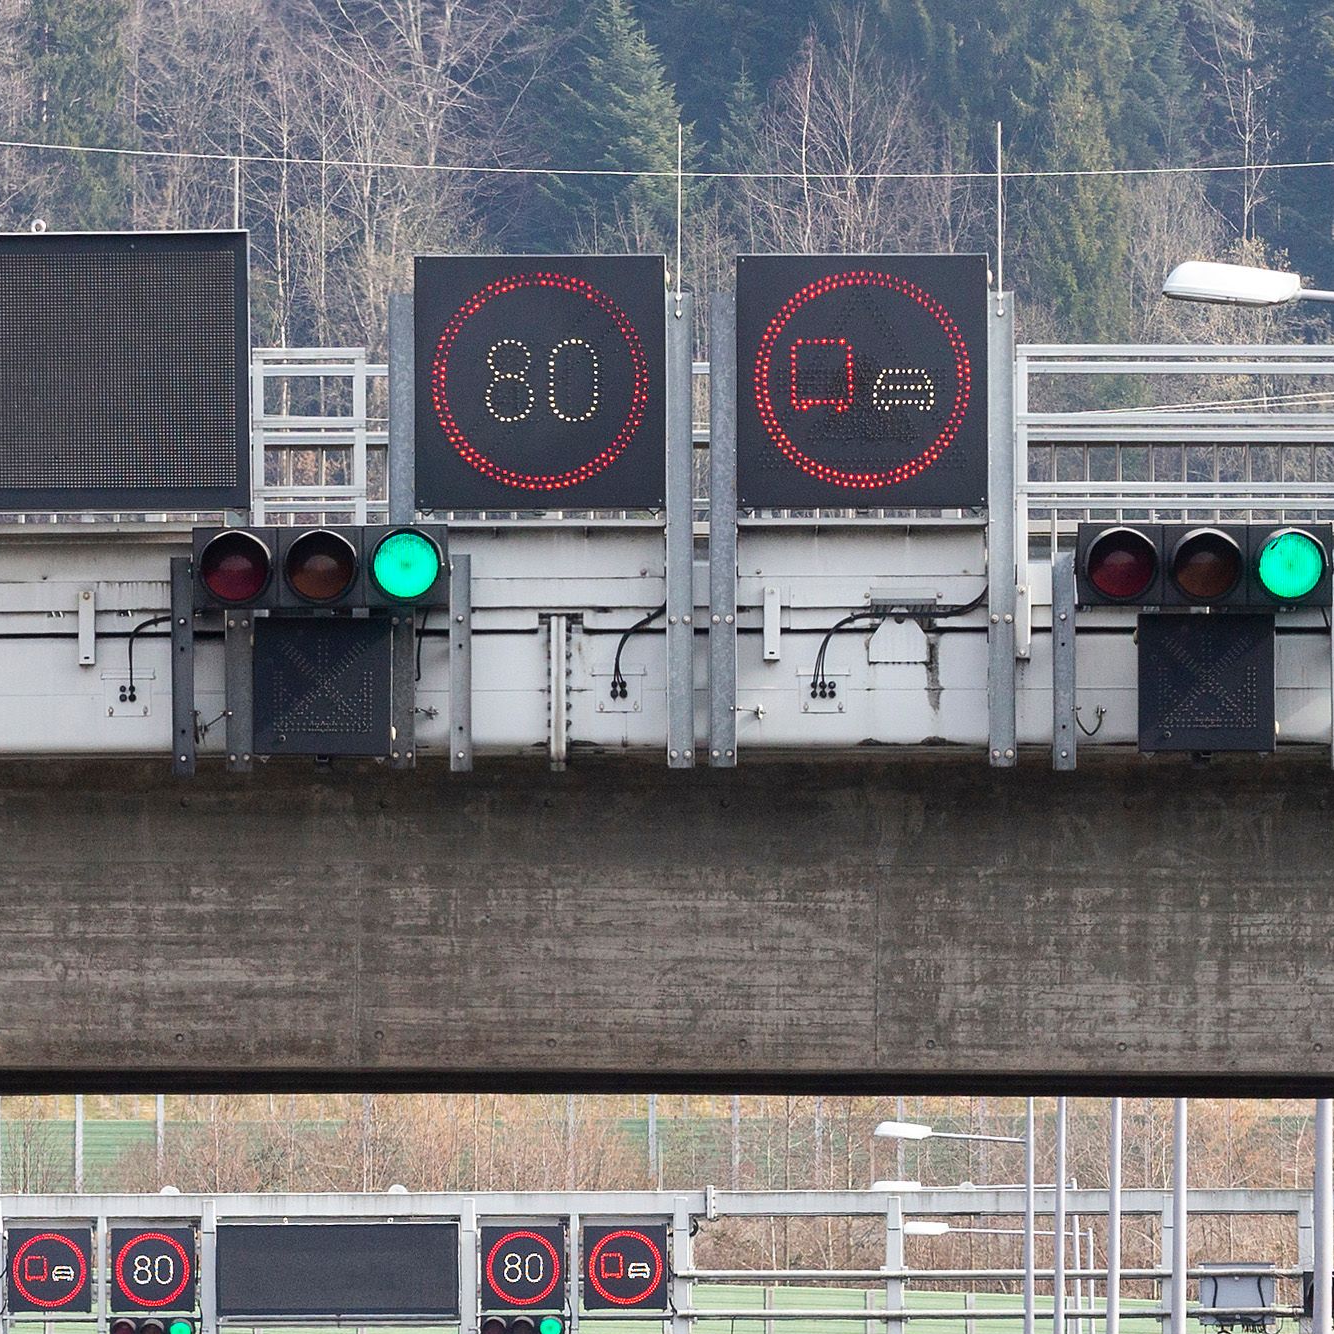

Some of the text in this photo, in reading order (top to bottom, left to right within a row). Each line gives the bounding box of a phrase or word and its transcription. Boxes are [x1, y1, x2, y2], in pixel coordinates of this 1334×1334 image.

[485, 338, 600, 422] 80
[133, 1255, 173, 1284] 80
[503, 1253, 543, 1282] 80
